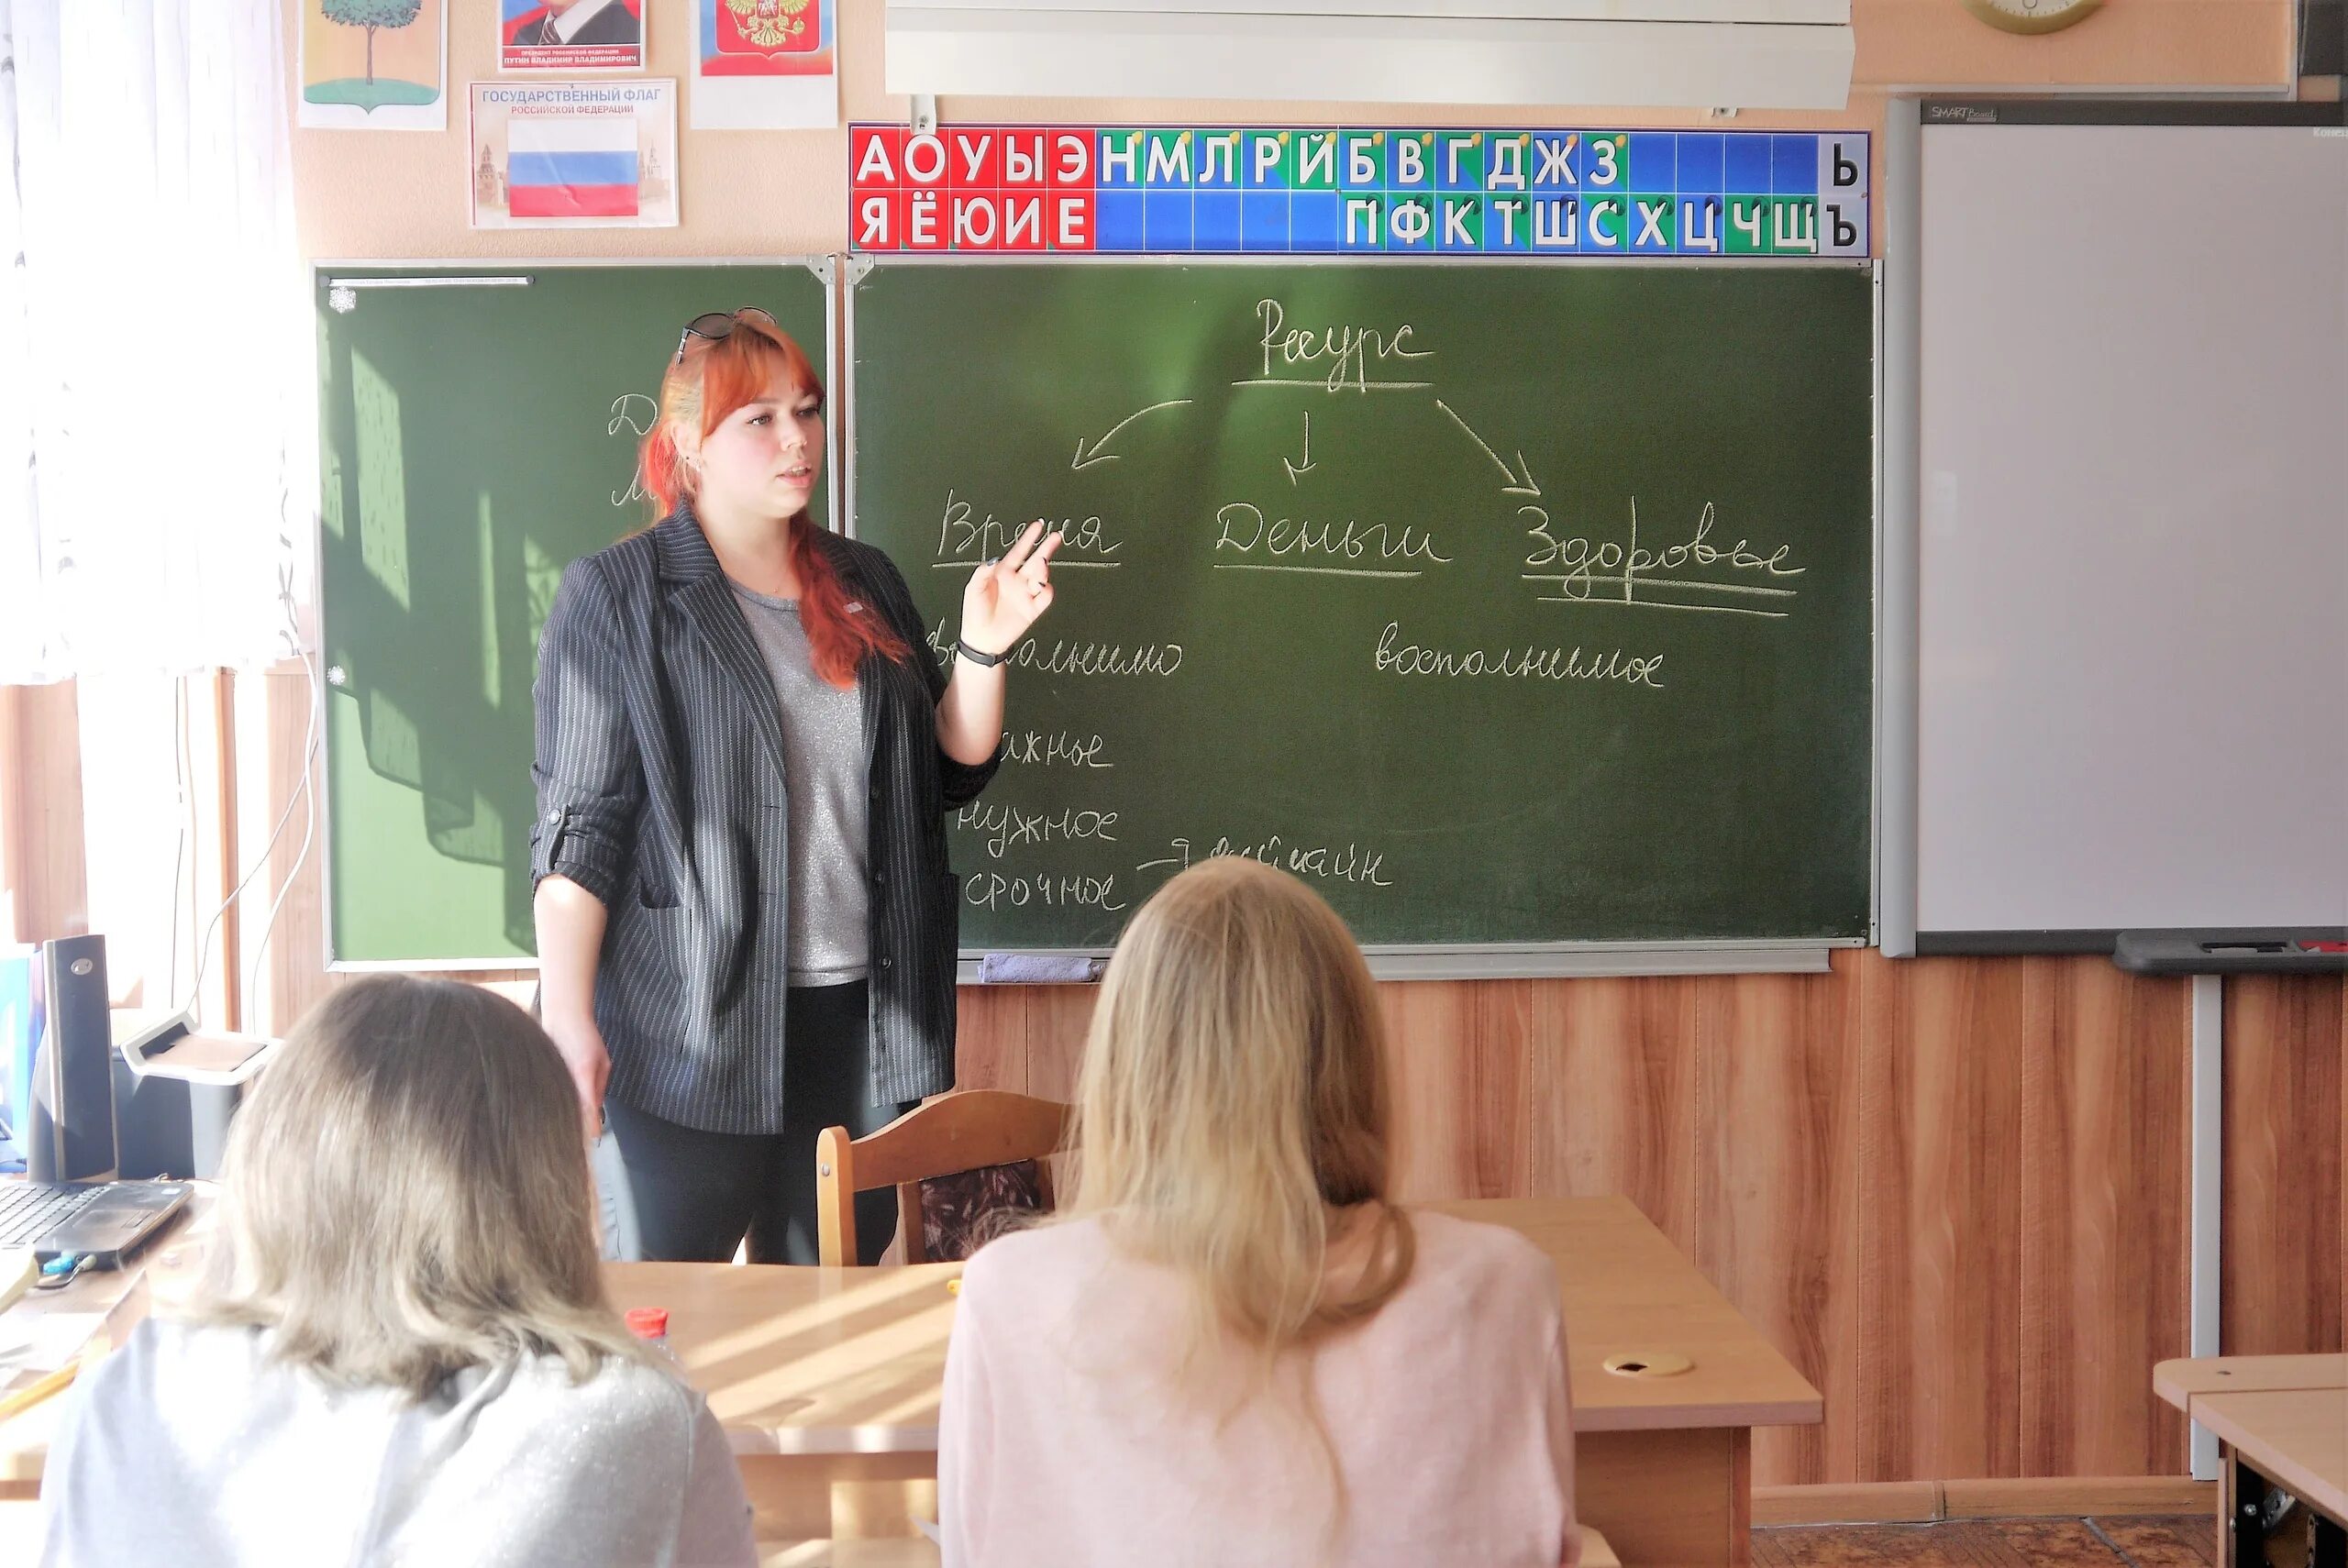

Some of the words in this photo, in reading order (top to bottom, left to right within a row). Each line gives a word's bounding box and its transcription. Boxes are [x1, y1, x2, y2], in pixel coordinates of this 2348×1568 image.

[574, 55, 637, 63] ВЛАДИМИРОВИЧ
[482, 88, 621, 104] ГОСУДАРСТВЕННЫЙ
[624, 88, 660, 101] ФЛАГ
[511, 105, 574, 115] РОССИЙСКОЙ
[576, 105, 634, 114] ФЕДЕРАЦИИ
[1932, 106, 1968, 117] SMART
[857, 135, 895, 181] А
[904, 135, 946, 182] О
[956, 136, 991, 181] У
[1006, 137, 1044, 182] Ы
[1058, 135, 1087, 182] Э
[1102, 137, 1135, 182] Н
[1146, 137, 1191, 182] М
[1199, 137, 1234, 182] Л
[1256, 137, 1282, 182] Р
[1299, 132, 1334, 183] Й
[1348, 138, 1377, 183] Б
[1398, 138, 1426, 183] В
[1448, 138, 1473, 183] Г
[1488, 138, 1525, 191] Д
[1533, 138, 1578, 184] Ж
[1589, 138, 1618, 184] З
[1833, 143, 1857, 186] Ь
[859, 198, 888, 243] Я
[912, 191, 936, 243] Ё
[954, 198, 996, 244] Ю
[1006, 197, 1040, 244] И
[1058, 198, 1085, 244] Е
[1346, 200, 1378, 245] П
[1390, 199, 1430, 245] Ф
[1449, 200, 1474, 246] К
[1493, 200, 1523, 246] Т
[1534, 199, 1577, 246] Ш
[1588, 198, 1618, 247] С
[1634, 201, 1667, 247] Х
[1684, 200, 1718, 252] Ц
[1732, 200, 1760, 248] Ч
[1773, 200, 1818, 253] Щ
[1827, 204, 1858, 246] Ъ
[1256, 298, 1435, 392] Ресурс
[936, 488, 1124, 563] Время
[1216, 502, 1454, 562] Деньги
[1518, 495, 1806, 603] Здоровье
[1376, 621, 1664, 688] восполнимое
[1001, 731, 1114, 767] ажное
[957, 800, 1117, 858] нужное
[965, 871, 1126, 911] срочное
